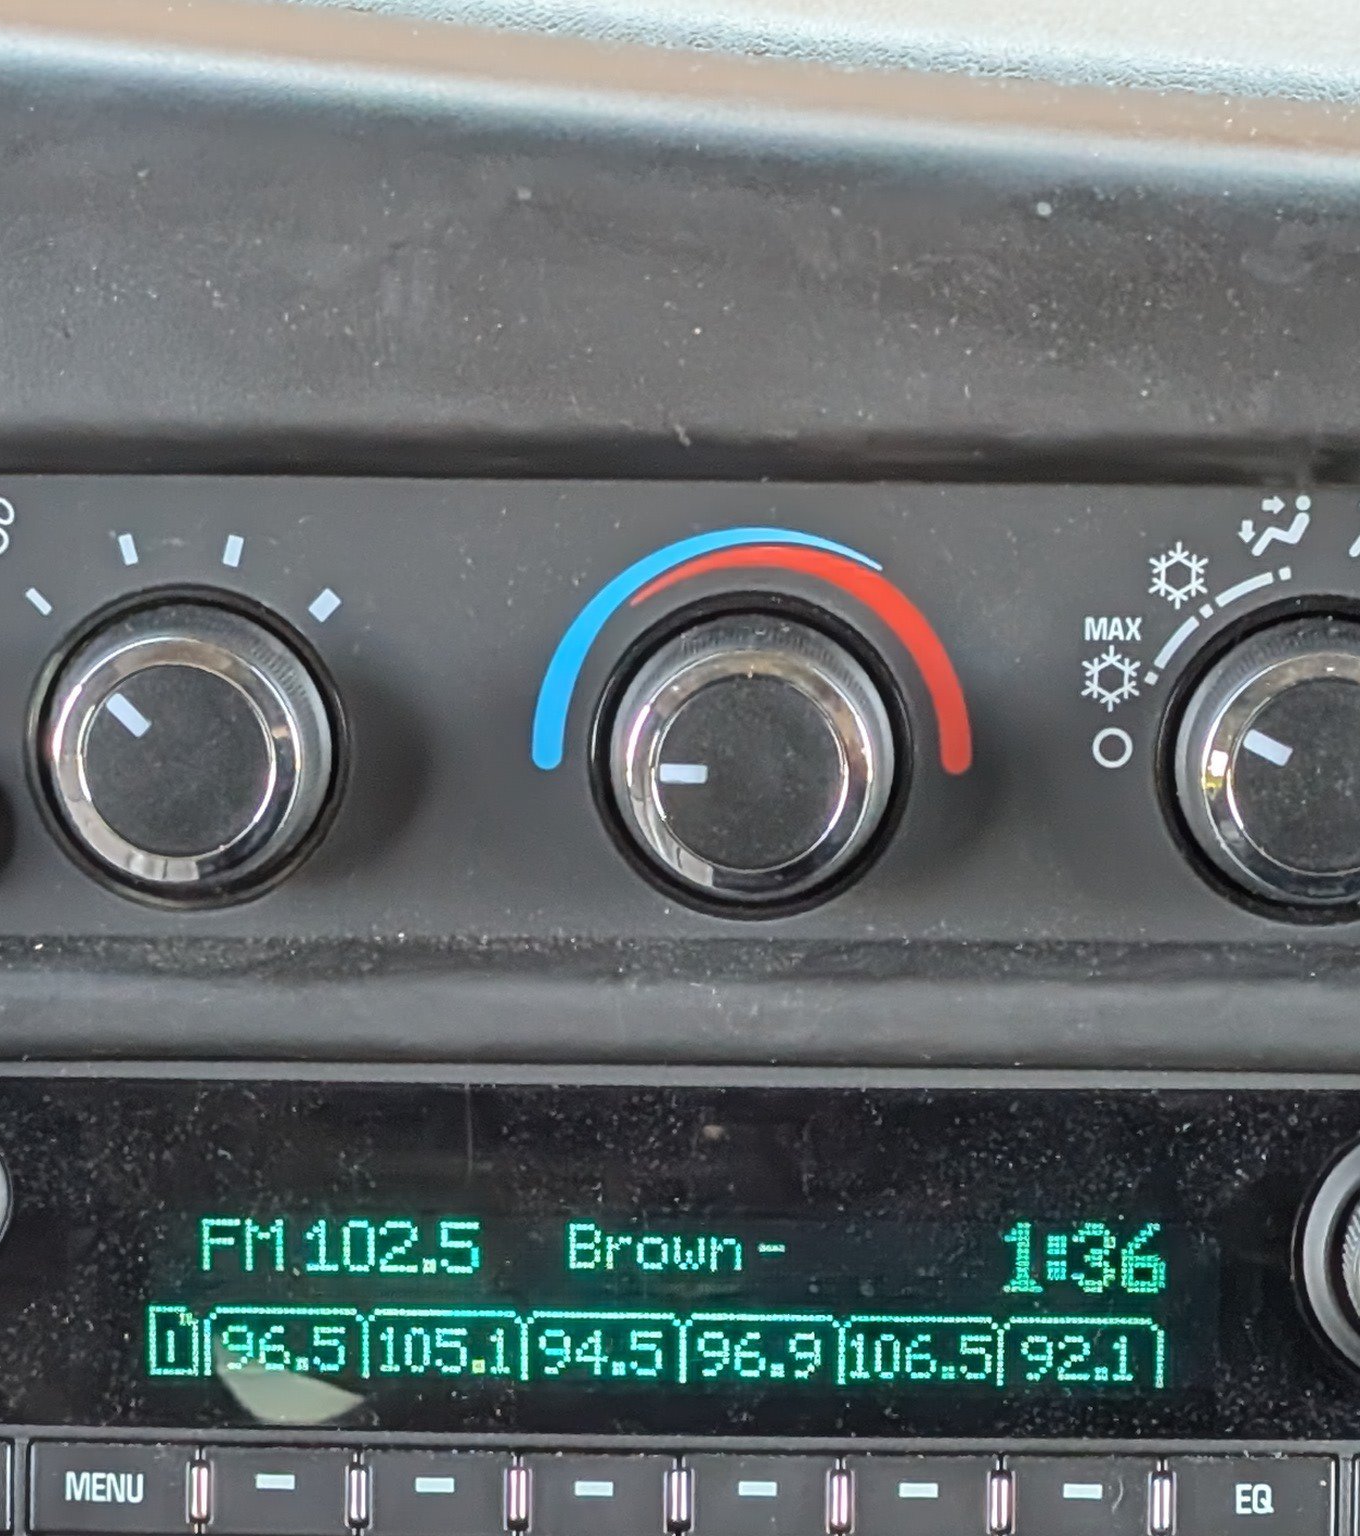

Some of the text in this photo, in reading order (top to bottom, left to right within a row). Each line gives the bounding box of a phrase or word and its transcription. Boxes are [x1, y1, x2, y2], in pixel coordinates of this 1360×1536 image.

[1084, 617, 1142, 642] MAX
[200, 1218, 285, 1272] FM
[304, 1218, 482, 1275] 102.5
[1002, 1221, 1167, 1294] 1:36
[220, 1323, 348, 1373] 96.5
[378, 1326, 511, 1374] 105.1
[538, 1328, 665, 1378] 94.5
[695, 1331, 822, 1379] 96.9
[848, 1333, 995, 1382] 106.5
[1020, 1335, 1133, 1383] 92.1
[64, 1471, 144, 1504] MENU
[1234, 1483, 1275, 1516] EQ
